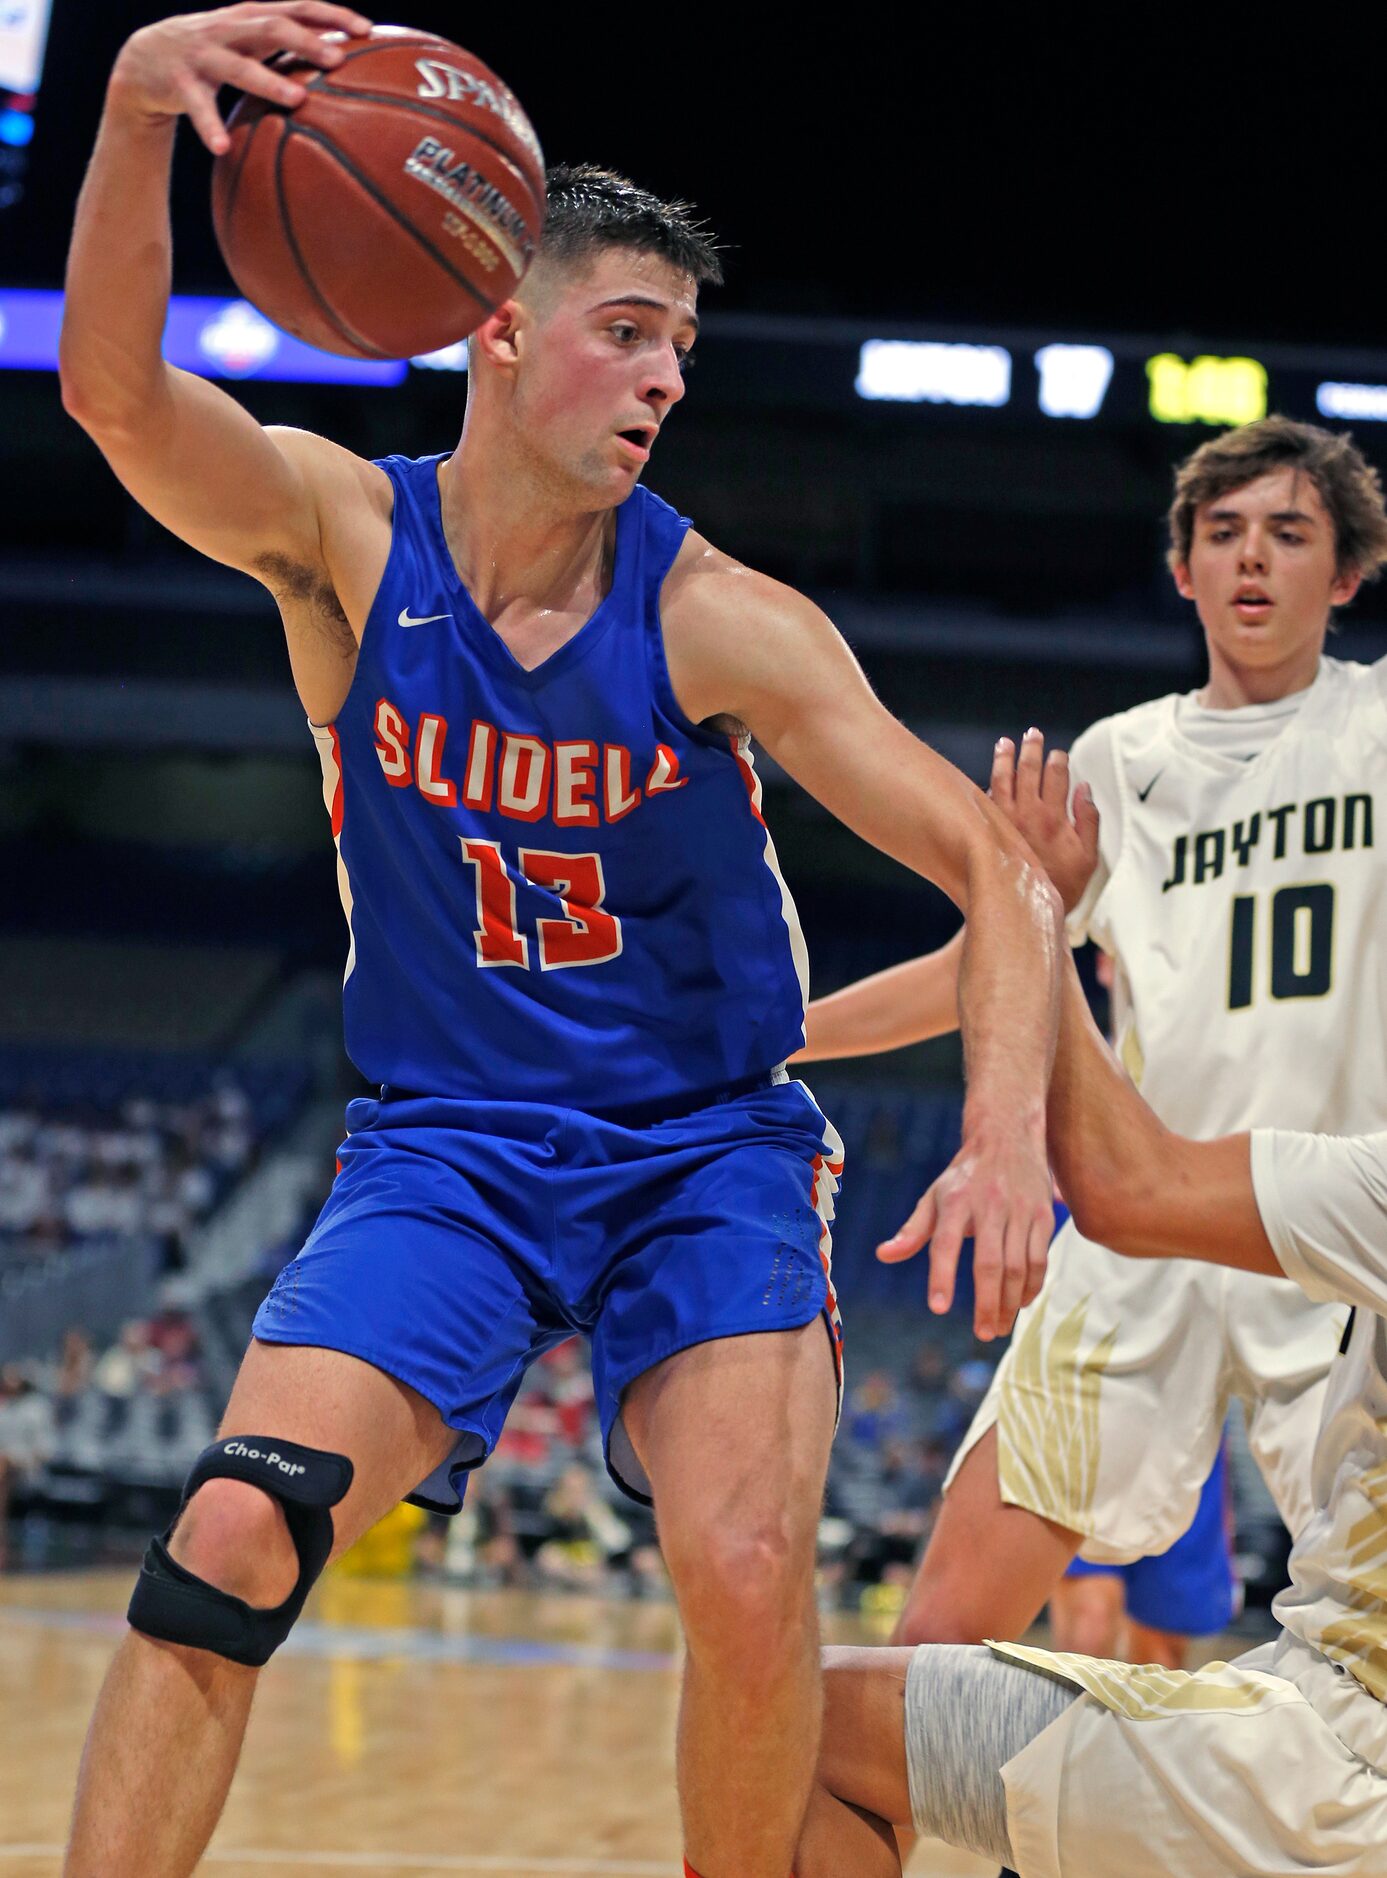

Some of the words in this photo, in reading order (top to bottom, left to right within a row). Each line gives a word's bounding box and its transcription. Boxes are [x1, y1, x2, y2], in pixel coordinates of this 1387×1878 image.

[374, 697, 689, 828] SLIDELL
[457, 835, 624, 972] 13
[1161, 793, 1374, 893] JAYTON
[1226, 880, 1336, 1015] 10
